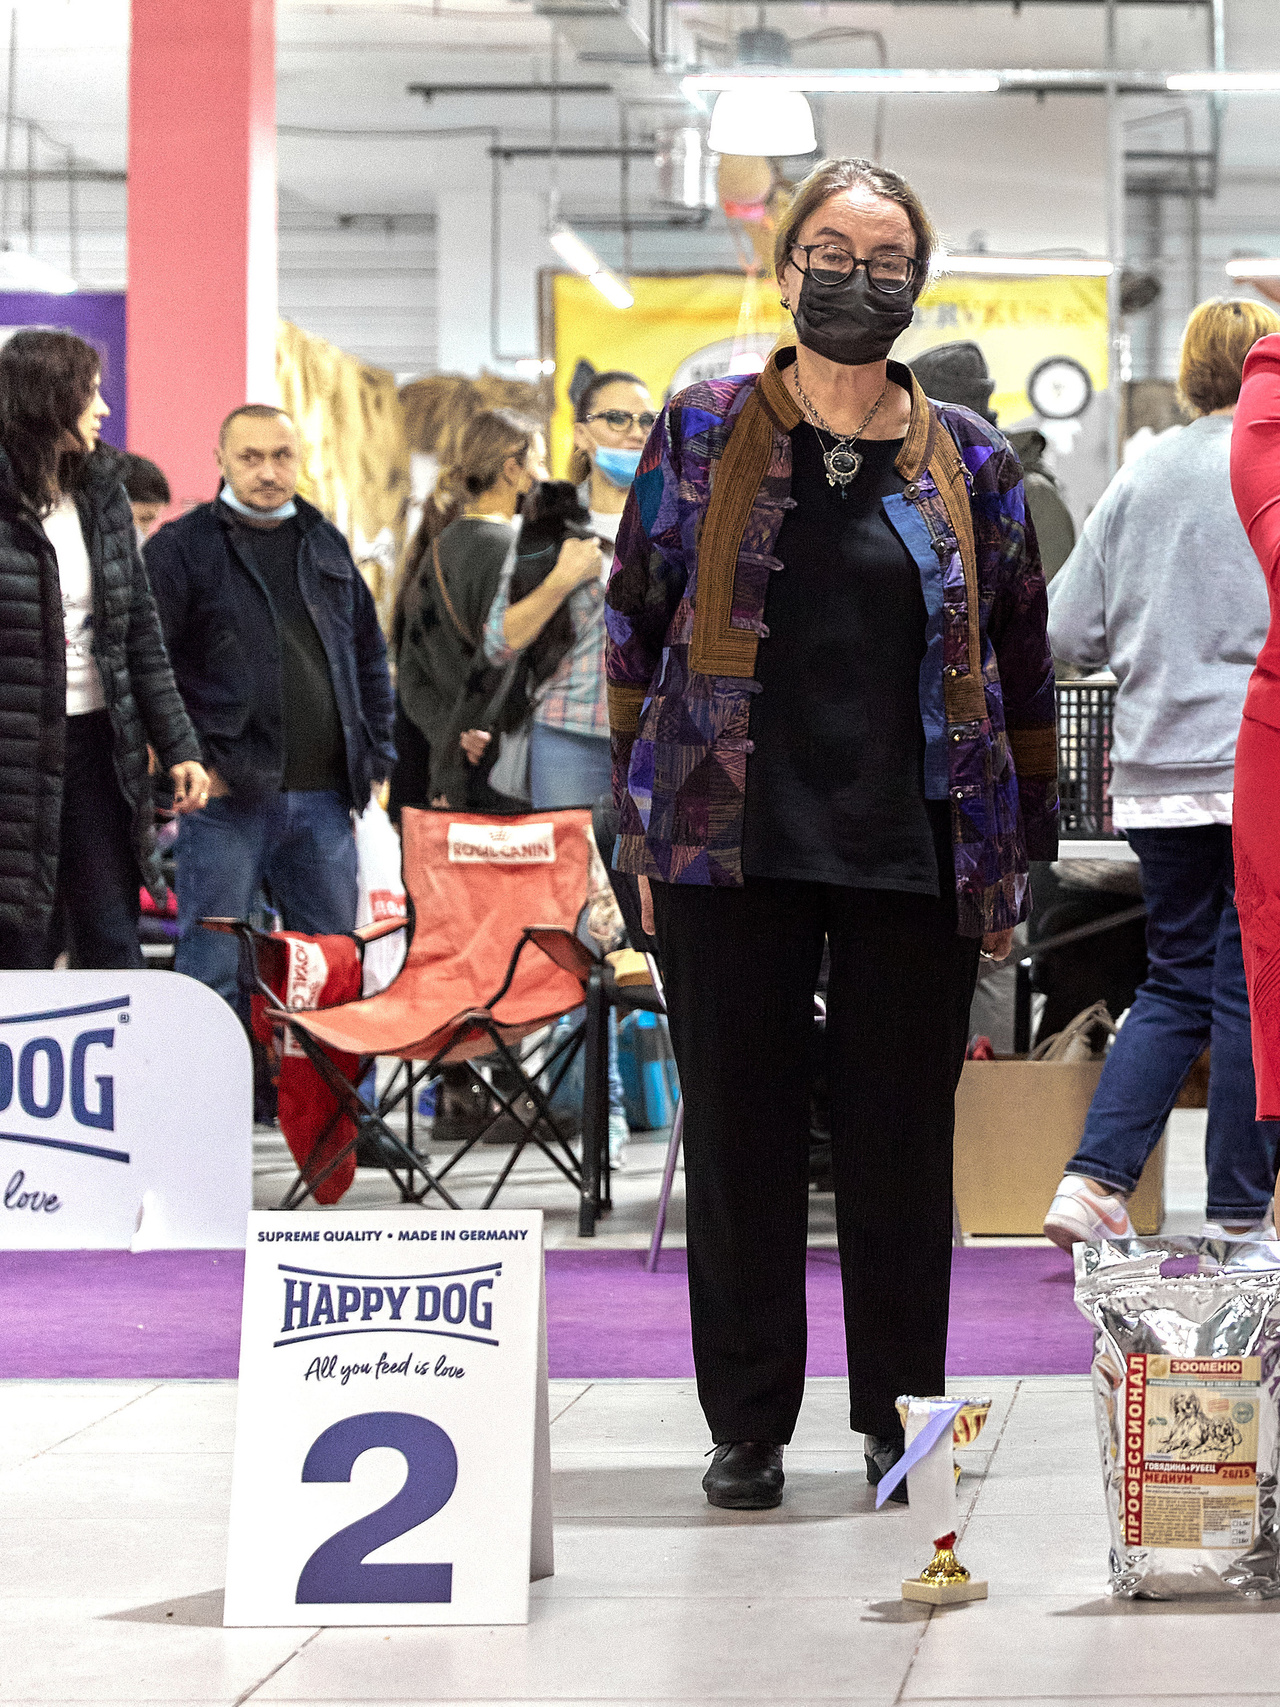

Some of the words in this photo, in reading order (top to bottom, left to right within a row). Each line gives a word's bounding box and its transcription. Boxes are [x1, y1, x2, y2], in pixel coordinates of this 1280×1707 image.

[0, 1027, 115, 1131] OG
[4, 1169, 61, 1212] love
[257, 1231, 320, 1242] SUPREME
[323, 1230, 382, 1242] QUALITY
[398, 1230, 437, 1241] MADE
[440, 1230, 455, 1240] IN
[457, 1229, 528, 1240] GERMANY
[280, 1277, 410, 1333] HAPPY
[415, 1277, 494, 1330] DOG
[304, 1355, 337, 1381] All
[340, 1363, 372, 1385] you
[374, 1352, 413, 1379] feed
[414, 1359, 430, 1376] is
[434, 1355, 466, 1379] love
[1171, 1361, 1241, 1373] ЗООМЕНЮ
[1127, 1356, 1145, 1543] ПРОФЕССИОНАЛ
[1144, 1472, 1193, 1484] МЕДИУМ
[295, 1411, 458, 1604] 2
